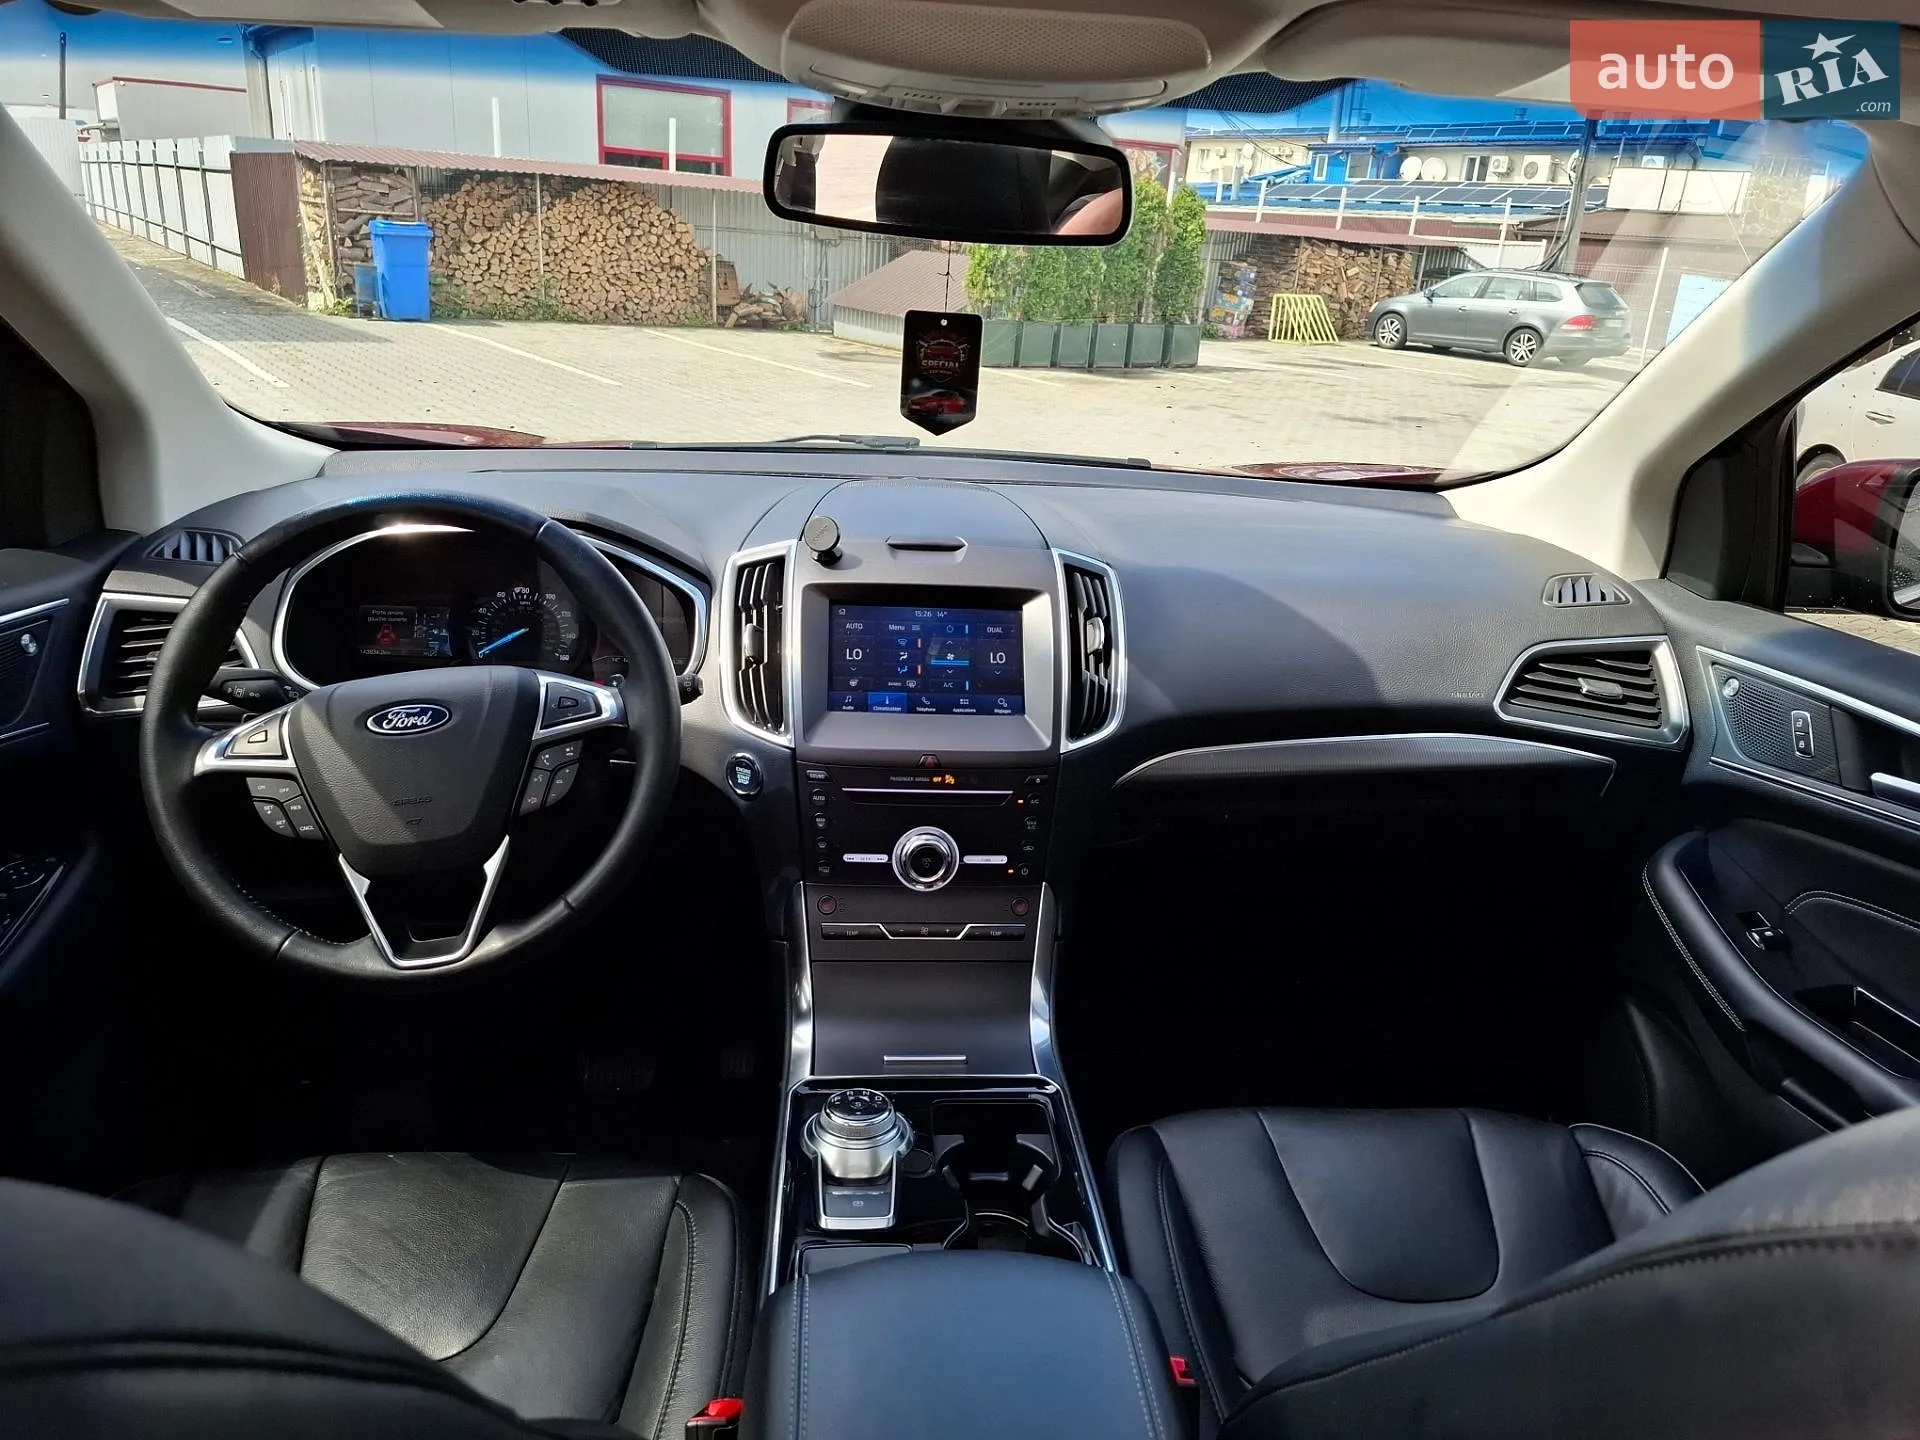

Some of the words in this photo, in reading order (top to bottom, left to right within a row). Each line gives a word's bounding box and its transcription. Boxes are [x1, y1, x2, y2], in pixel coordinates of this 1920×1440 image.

[915, 610, 932, 618] 15:26
[845, 622, 863, 630] AUTO
[846, 648, 863, 660] LO
[990, 652, 1006, 664] LO
[382, 708, 433, 729] Ford
